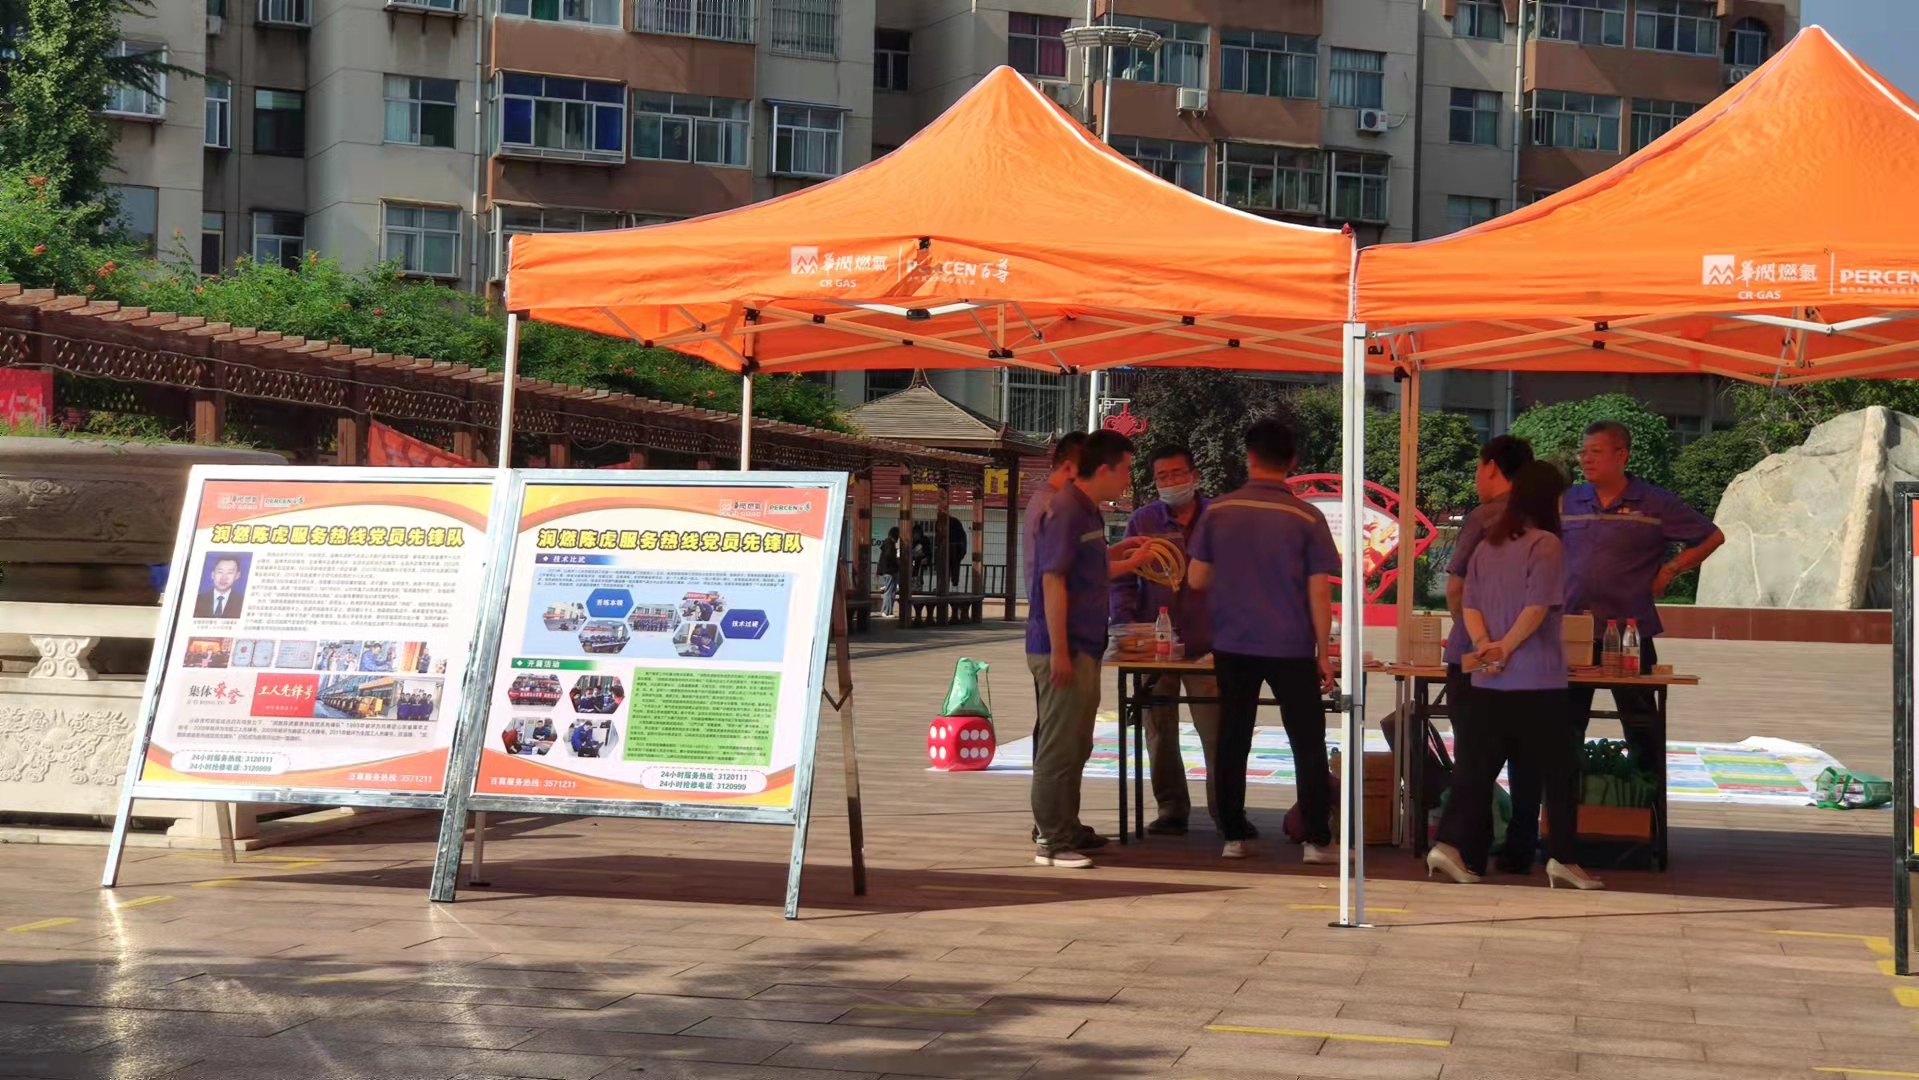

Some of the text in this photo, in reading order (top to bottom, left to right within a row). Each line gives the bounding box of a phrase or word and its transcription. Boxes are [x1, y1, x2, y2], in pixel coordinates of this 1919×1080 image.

[819, 279, 857, 288] CR GAS
[1738, 290, 1781, 300] CR GAS
[212, 523, 465, 547] 润燃陈虎服务热线党员先锋队
[537, 527, 804, 553] 润燃陈虎服务热线党员先锋队
[553, 555, 586, 564] 技术比武
[526, 659, 560, 669] 开展活动
[257, 684, 314, 702] 工人先锋号
[717, 772, 748, 781] 3120111
[544, 779, 576, 789] 3571211
[716, 782, 747, 791] 3120999
